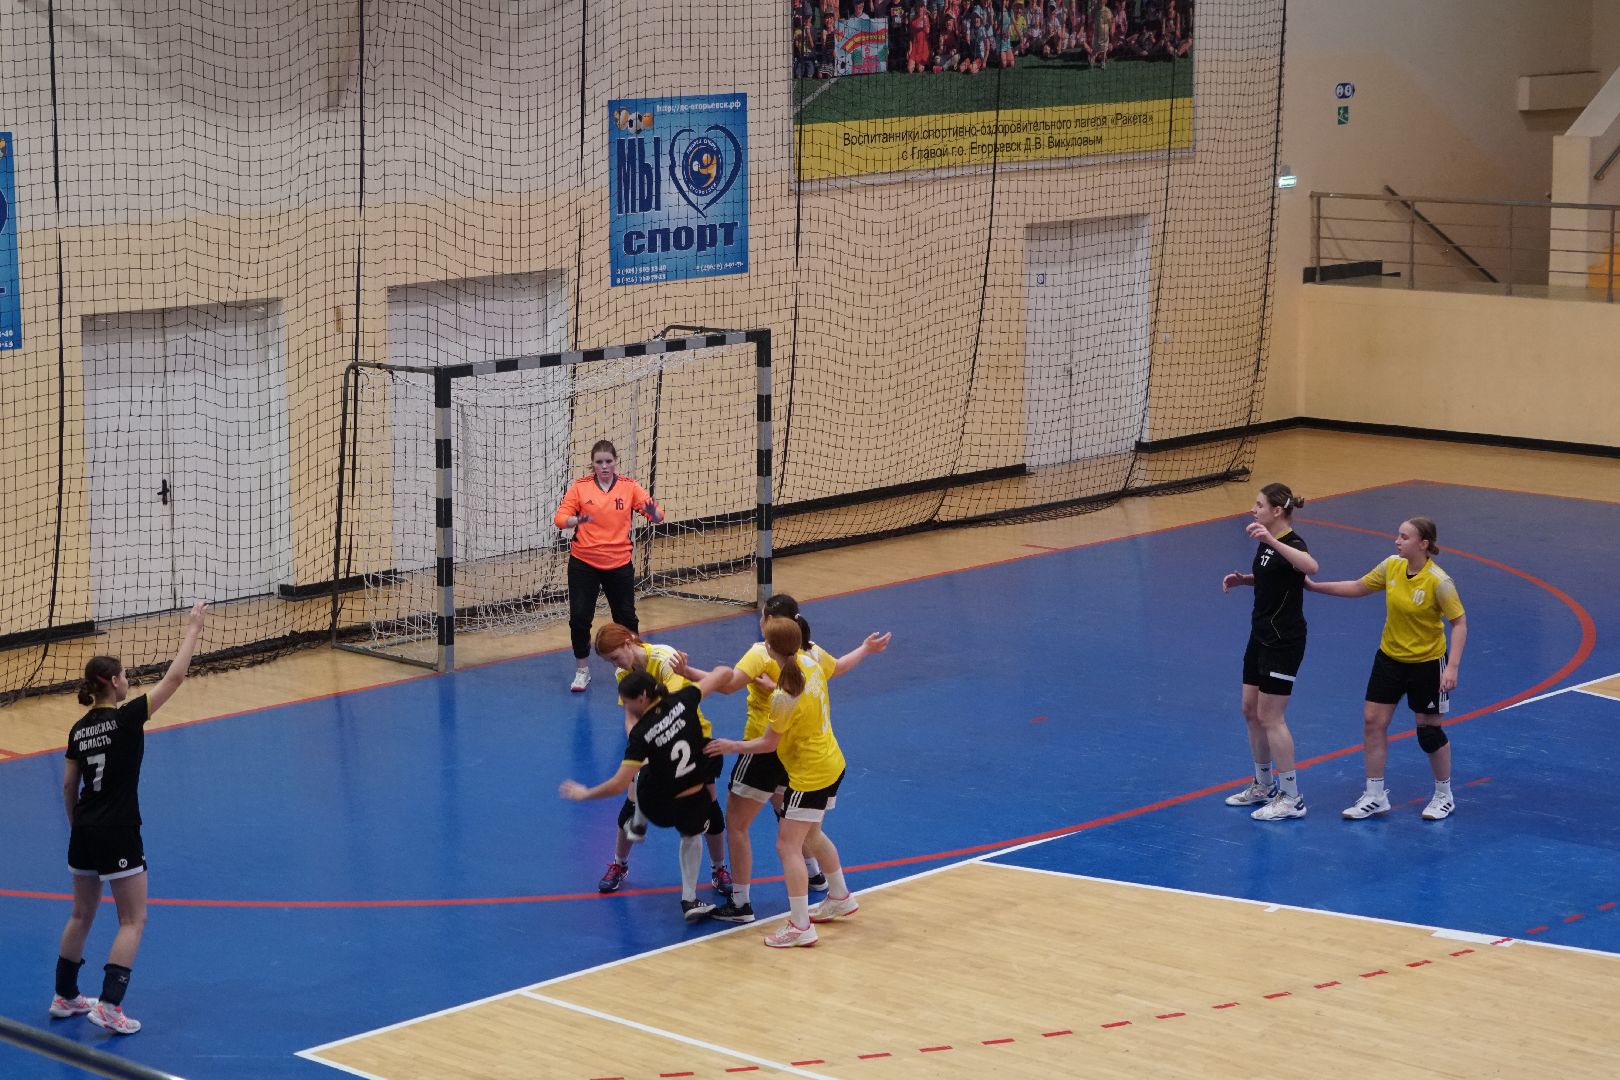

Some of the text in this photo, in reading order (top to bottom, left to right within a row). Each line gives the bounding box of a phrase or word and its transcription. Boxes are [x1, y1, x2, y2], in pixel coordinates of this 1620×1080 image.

[843, 128, 920, 147] Воспитанники
[1075, 115, 1107, 129] лагеря
[1110, 112, 1153, 126] «Ракета»
[911, 143, 948, 160] Главой
[1047, 133, 1103, 152] Викуловым
[616, 136, 662, 215] МЫ
[614, 497, 624, 510] 16
[1260, 554, 1271, 567] 17
[1412, 588, 1426, 606] 10
[73, 719, 119, 742] МОСКОВСКАЯ
[79, 734, 112, 752] ОБЛАСТЬ
[655, 718, 687, 748] ОБЛАСТЬ
[86, 752, 106, 792] 7
[670, 739, 697, 778] 2
